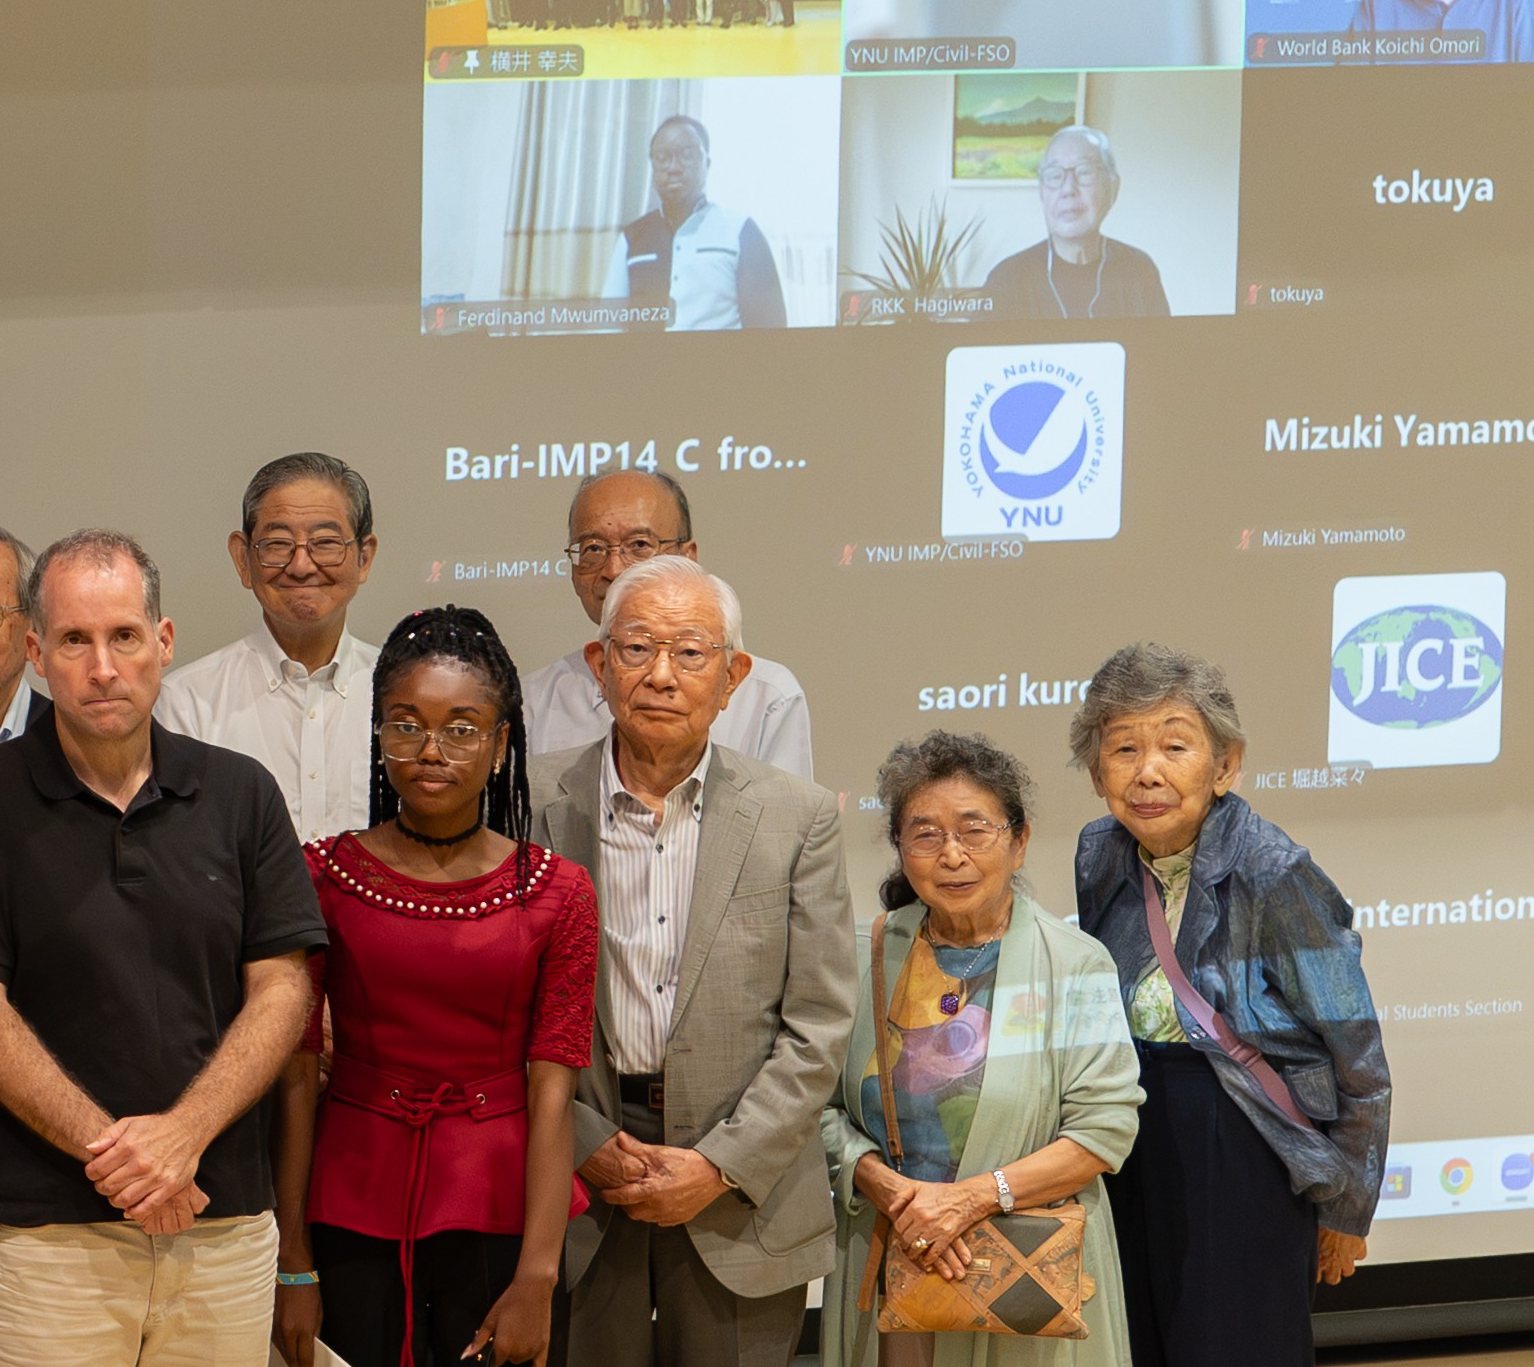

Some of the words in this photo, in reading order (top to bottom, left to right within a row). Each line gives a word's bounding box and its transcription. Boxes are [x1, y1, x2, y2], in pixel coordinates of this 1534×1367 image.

[851, 47, 888, 64] YNU
[895, 44, 1009, 64] IMP/Civil-FSO
[1277, 38, 1327, 56] World
[1332, 39, 1370, 54] Bank
[1376, 38, 1424, 54] Koichi
[1430, 37, 1480, 53] Omori
[1373, 170, 1495, 212] tokuya
[872, 298, 904, 315] RKK
[915, 295, 993, 316] Hagiwara
[1270, 285, 1324, 305] tokuya
[458, 309, 545, 326] Ferdinand
[551, 306, 670, 323] Mwumvaneza
[960, 382, 995, 497] YOKOHAMA
[1003, 360, 1083, 387] National
[1077, 391, 1104, 494] University
[1265, 414, 1382, 452] Mizuki
[446, 441, 658, 480] Bari-IMP14
[675, 438, 700, 472] C
[1000, 506, 1063, 528] YNU
[1263, 529, 1316, 546] Mizuki
[1321, 526, 1406, 544] Yamamoto
[866, 546, 902, 562] YNU
[908, 542, 1023, 562] IMP/Civil-FSO
[455, 560, 550, 580] Bari-IMP14
[1352, 637, 1486, 706] JICE
[918, 674, 1008, 711] saori
[1255, 773, 1285, 790] JICE
[1348, 889, 1534, 929] nternation
[1394, 1004, 1460, 1020] Students
[1465, 998, 1522, 1015] Section
